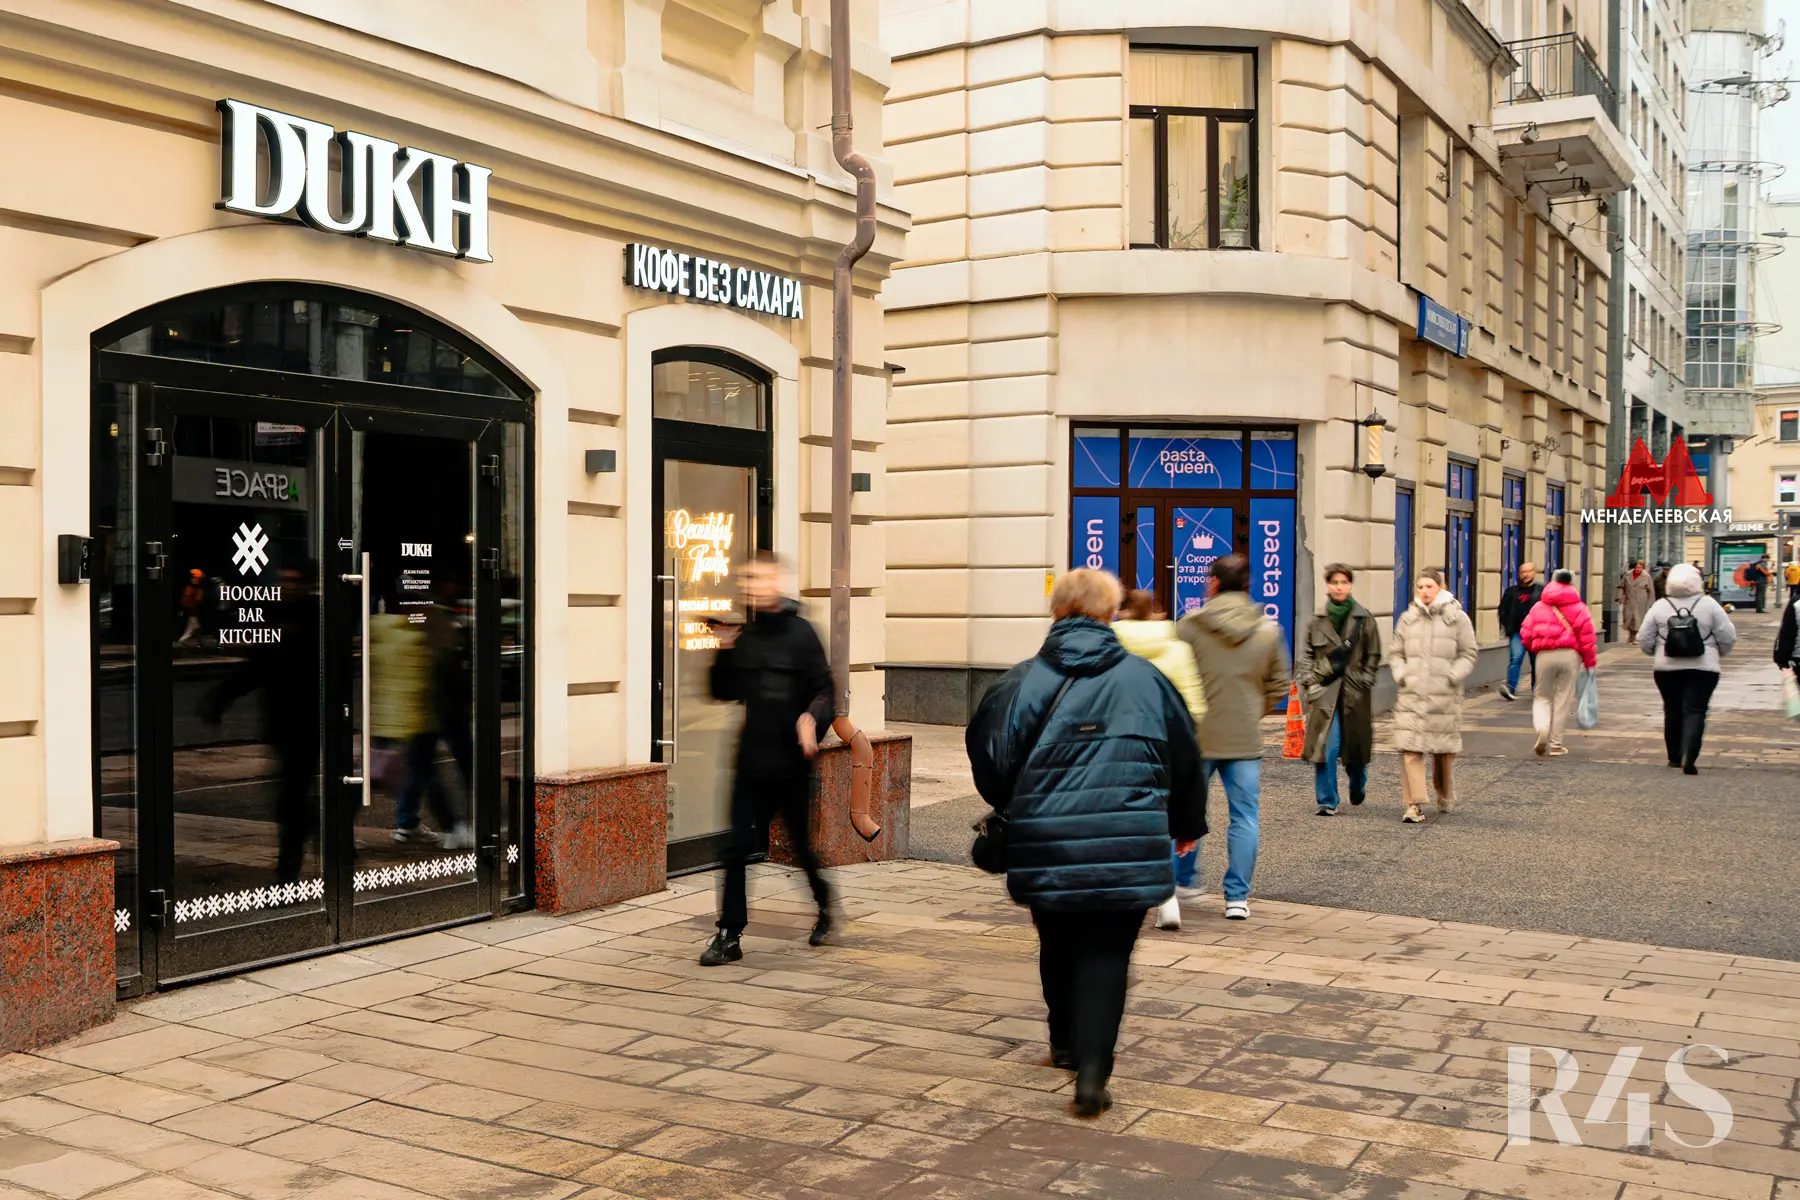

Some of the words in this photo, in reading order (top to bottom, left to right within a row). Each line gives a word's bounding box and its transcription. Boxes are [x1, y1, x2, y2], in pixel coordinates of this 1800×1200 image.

[221, 97, 493, 263] DUKH
[633, 242, 690, 297] КОФЕ
[695, 256, 731, 304] БЕЗ
[736, 266, 804, 320] САХАРА
[1160, 449, 1206, 466] pasta
[1164, 462, 1215, 478] queen
[1684, 524, 1701, 533] AFE
[1729, 523, 1764, 532] PRIME
[401, 542, 432, 557] DUKH
[1086, 518, 1104, 571] een
[1258, 520, 1282, 597] pasta
[1178, 565, 1195, 573] эта
[1177, 575, 1212, 586] открое
[219, 585, 282, 601] HOOKAH
[238, 607, 265, 622] BAR
[219, 628, 282, 644] KITCHEN
